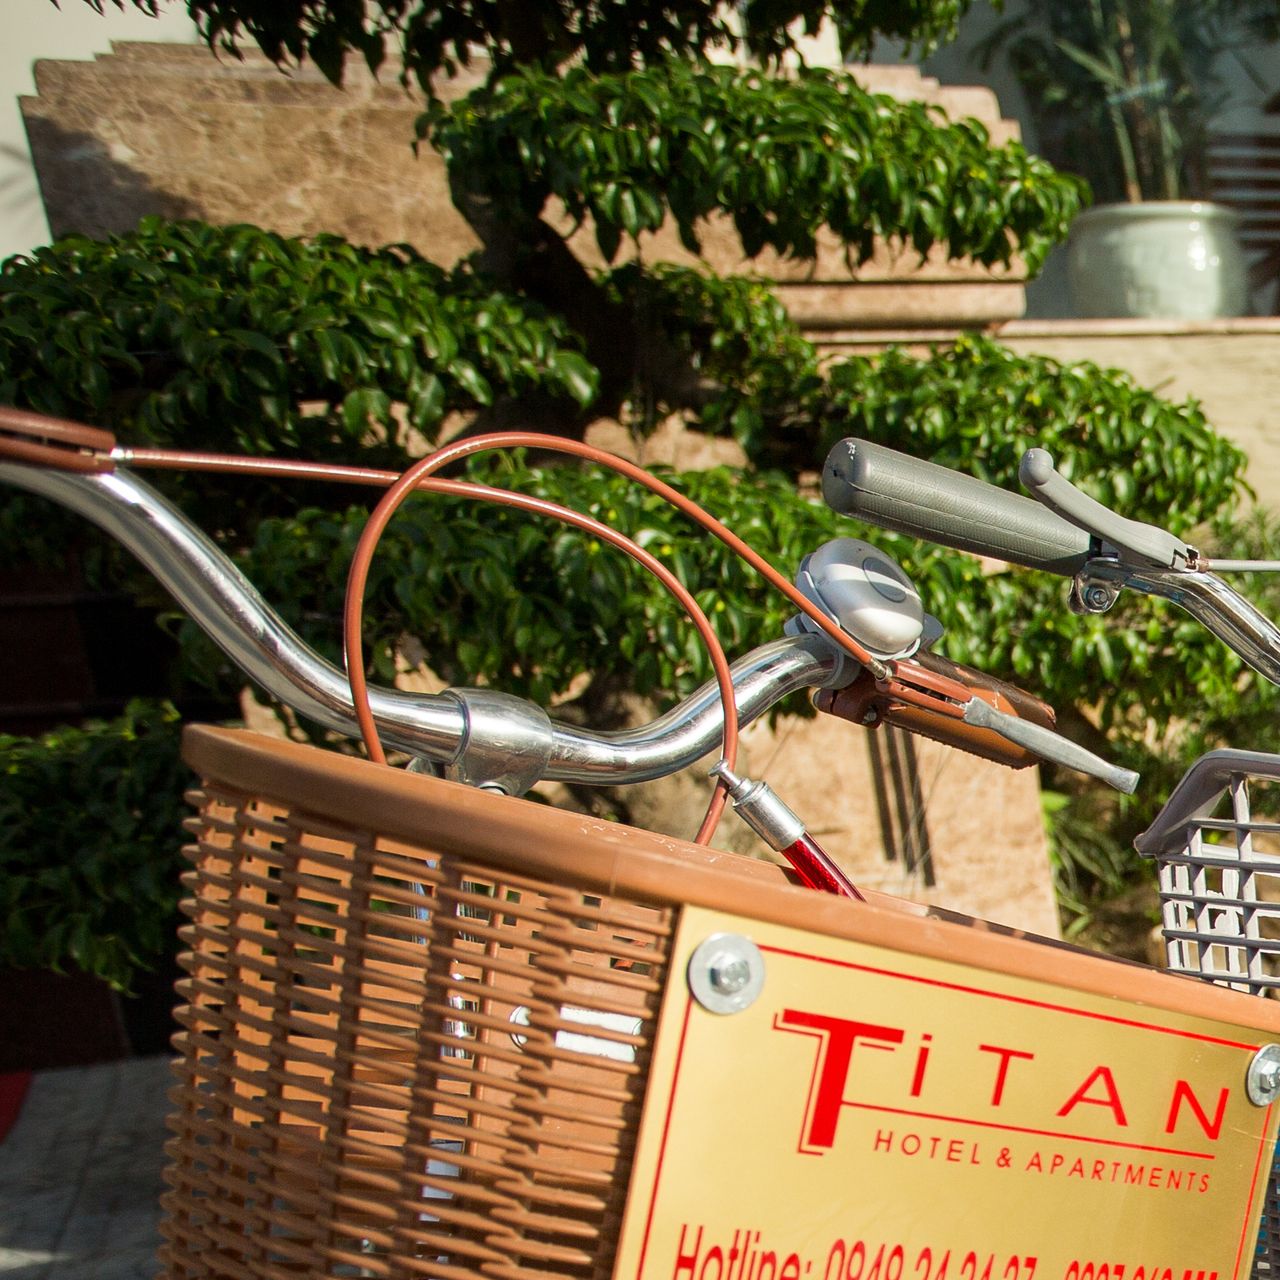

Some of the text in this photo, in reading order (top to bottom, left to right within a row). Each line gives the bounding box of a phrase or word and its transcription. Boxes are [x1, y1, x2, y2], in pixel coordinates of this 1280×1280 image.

[874, 1129, 1210, 1193] HOTEL & APARTMENTS
